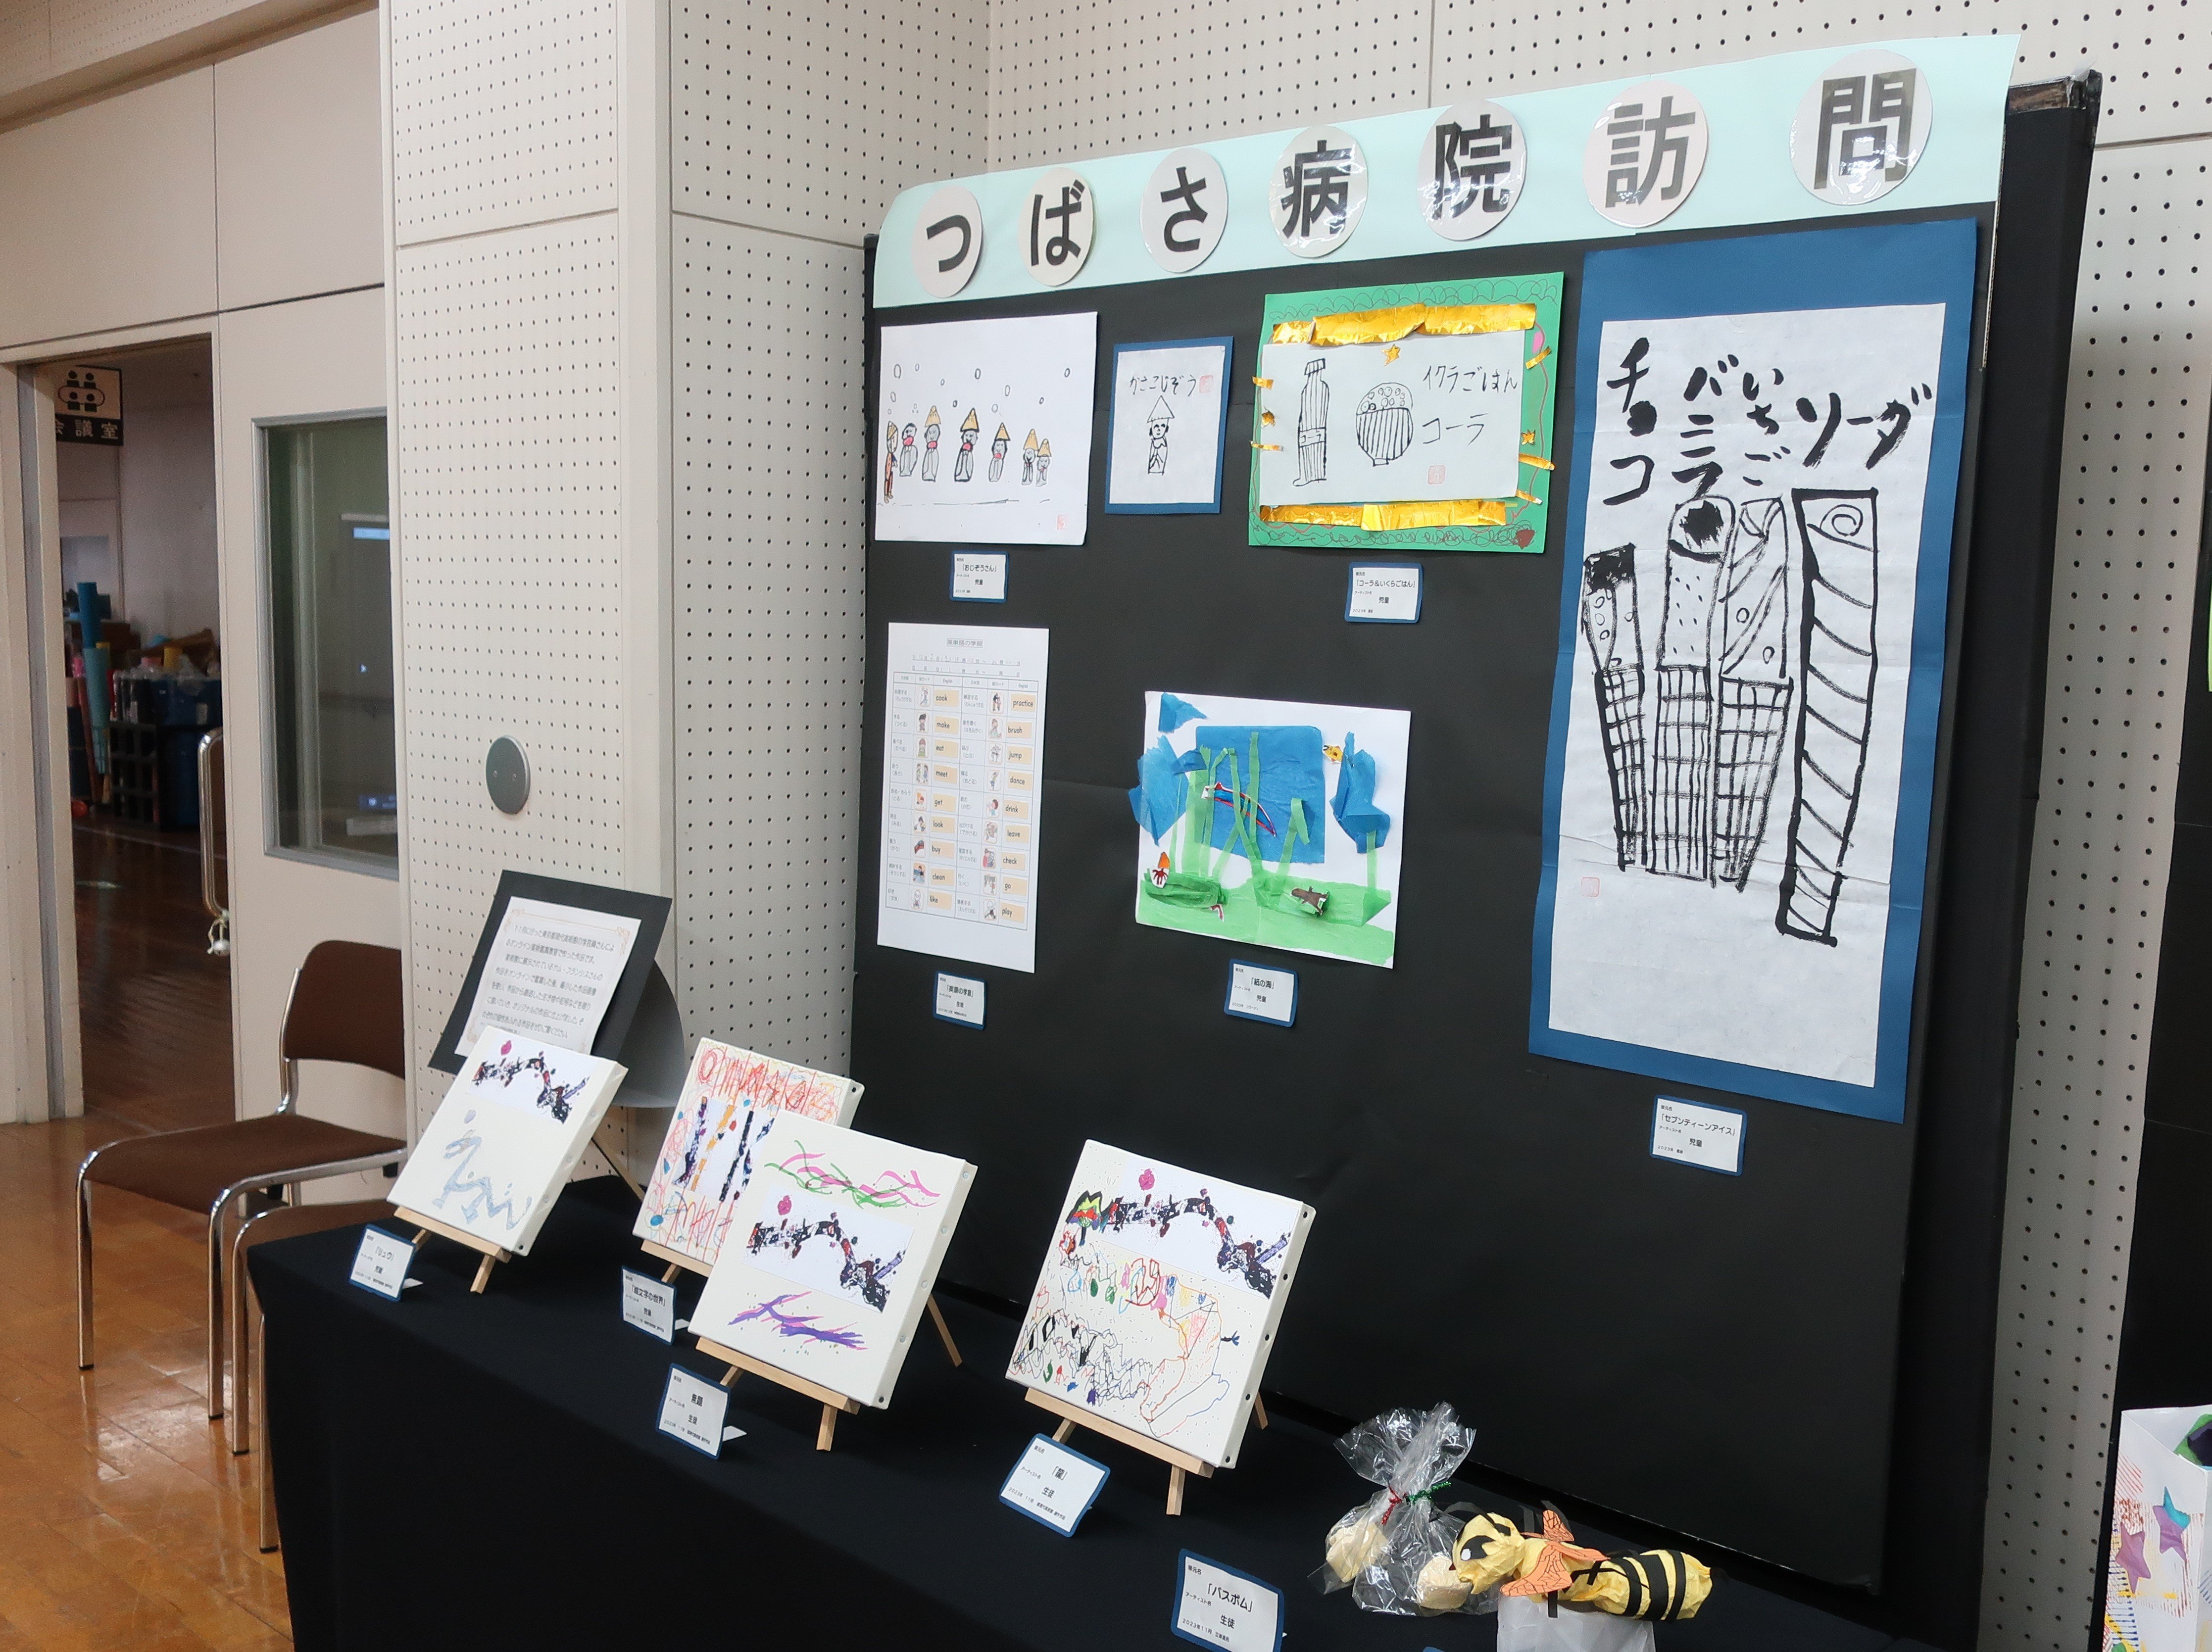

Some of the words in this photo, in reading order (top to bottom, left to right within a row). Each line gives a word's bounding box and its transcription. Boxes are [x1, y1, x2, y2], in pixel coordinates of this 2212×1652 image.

[927, 68, 1917, 274] つばさ病院訪問
[1422, 365, 1519, 393] イクラごはん
[1422, 413, 1490, 446] コーラ
[1796, 383, 1932, 470] ソーダ
[1356, 580, 1415, 588] 「コーラ&いくらごはん」
[1008, 751, 1022, 760] jump
[1010, 777, 1025, 785] dance
[932, 845, 941, 855] buy
[1002, 907, 1012, 917] play
[1251, 977, 1275, 989] 「紙の海」
[1662, 1114, 1735, 1136] 「セブンティーンアイス」
[1689, 1138, 1702, 1148] 児童
[1041, 1487, 1055, 1498] 生徒
[1185, 1591, 1212, 1606] アーティスト名
[1220, 1614, 1235, 1629] 生徒
